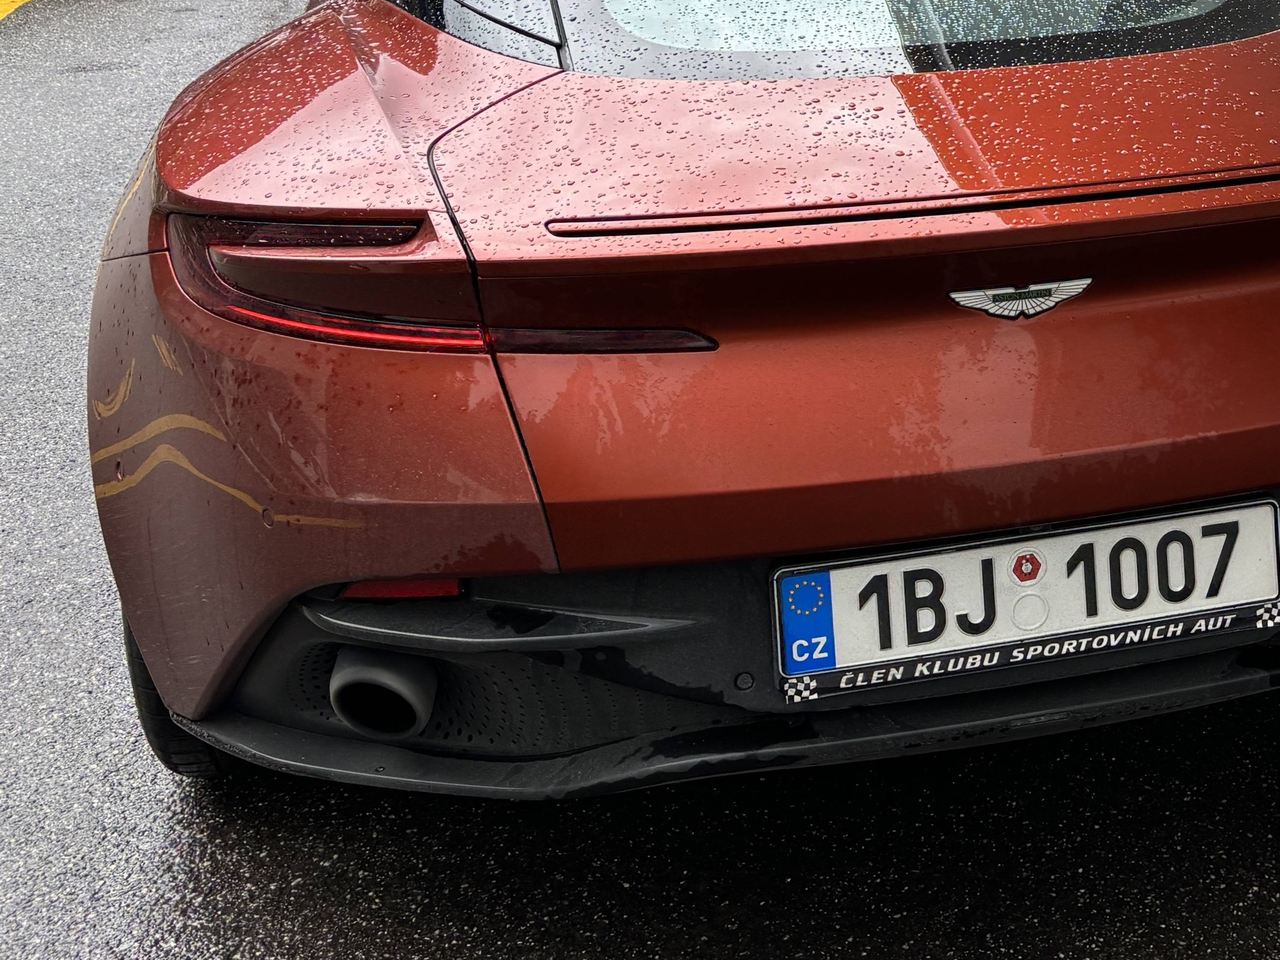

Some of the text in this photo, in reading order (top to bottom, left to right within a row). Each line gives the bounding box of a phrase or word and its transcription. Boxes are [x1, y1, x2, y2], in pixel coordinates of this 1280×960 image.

[994, 290, 1050, 302] ASTON MARTIN
[858, 520, 1240, 653] 1BJ 1007
[791, 636, 829, 663] CZ
[839, 613, 1237, 689] ČLEN KLUBU SPORTOVNÍCH AUT
